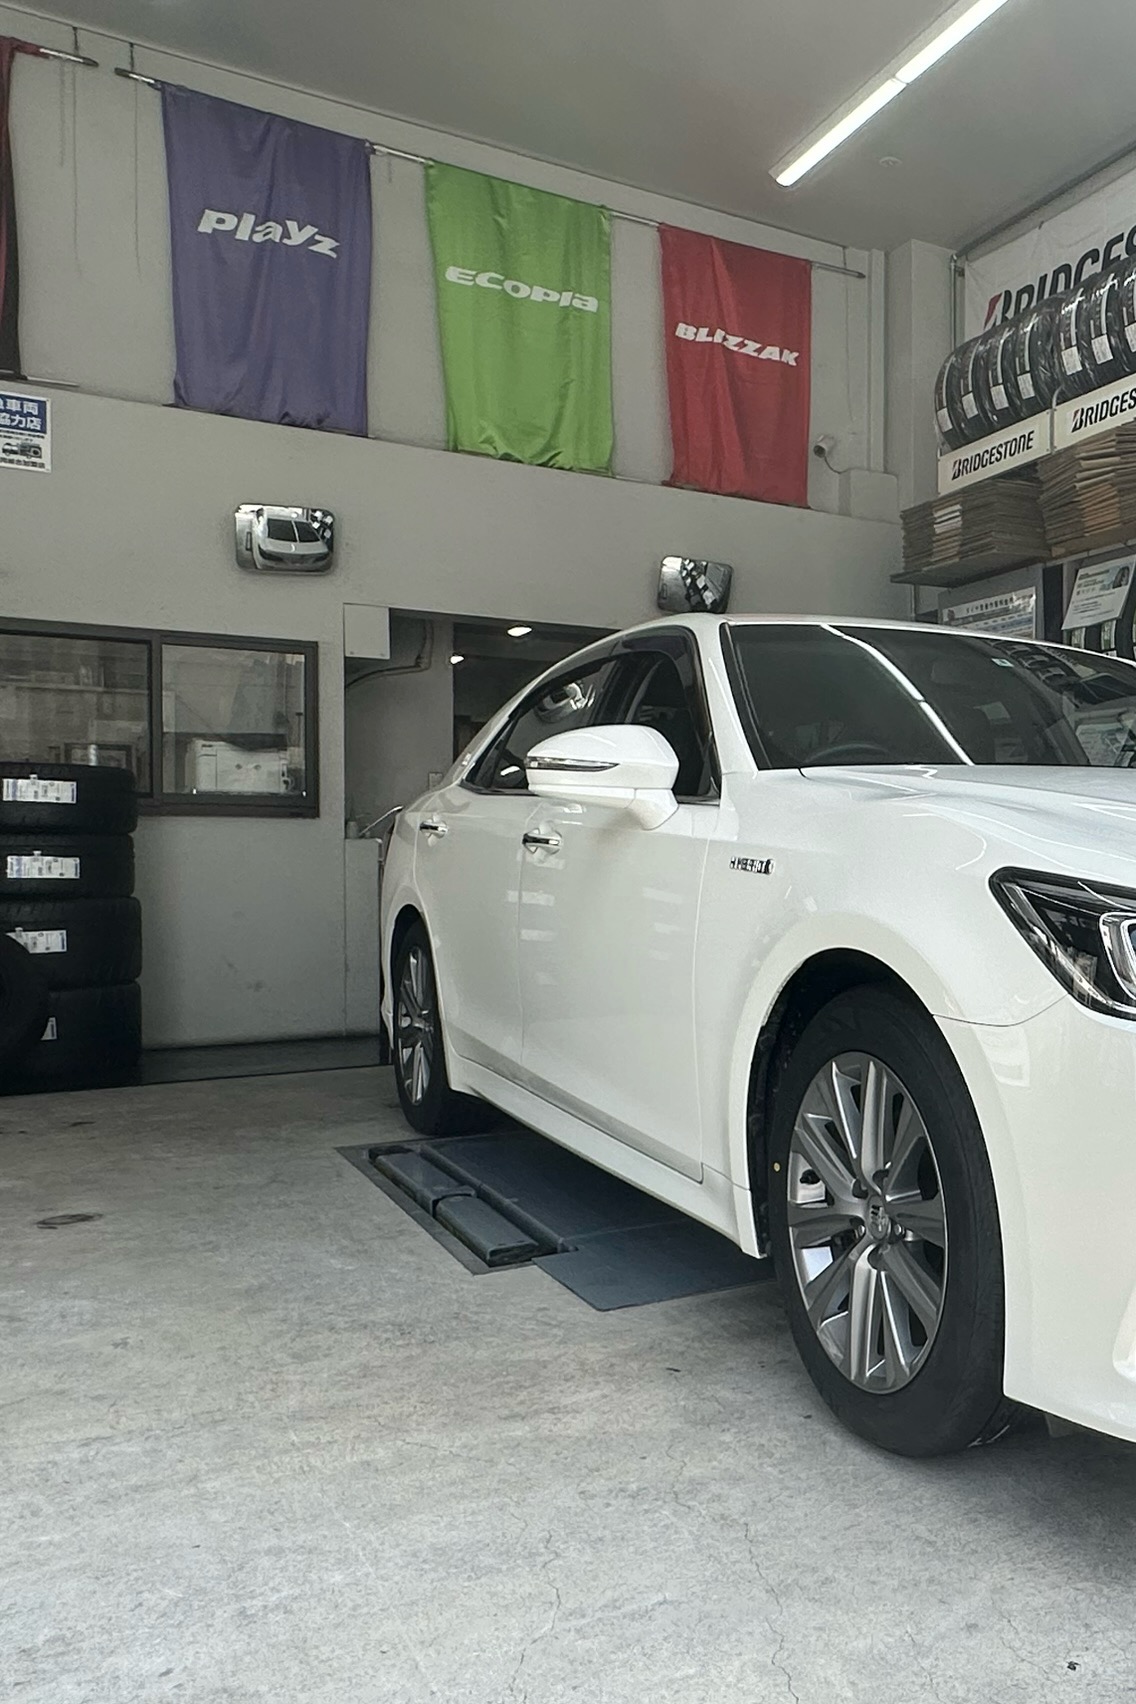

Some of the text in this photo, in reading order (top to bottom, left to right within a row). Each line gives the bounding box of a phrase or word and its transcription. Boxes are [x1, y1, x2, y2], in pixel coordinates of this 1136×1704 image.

[197, 208, 341, 259] Playz
[675, 322, 800, 366] BLIZZAK
[0, 398, 39, 415] 車両
[951, 430, 1035, 481] BRIDGESTONE
